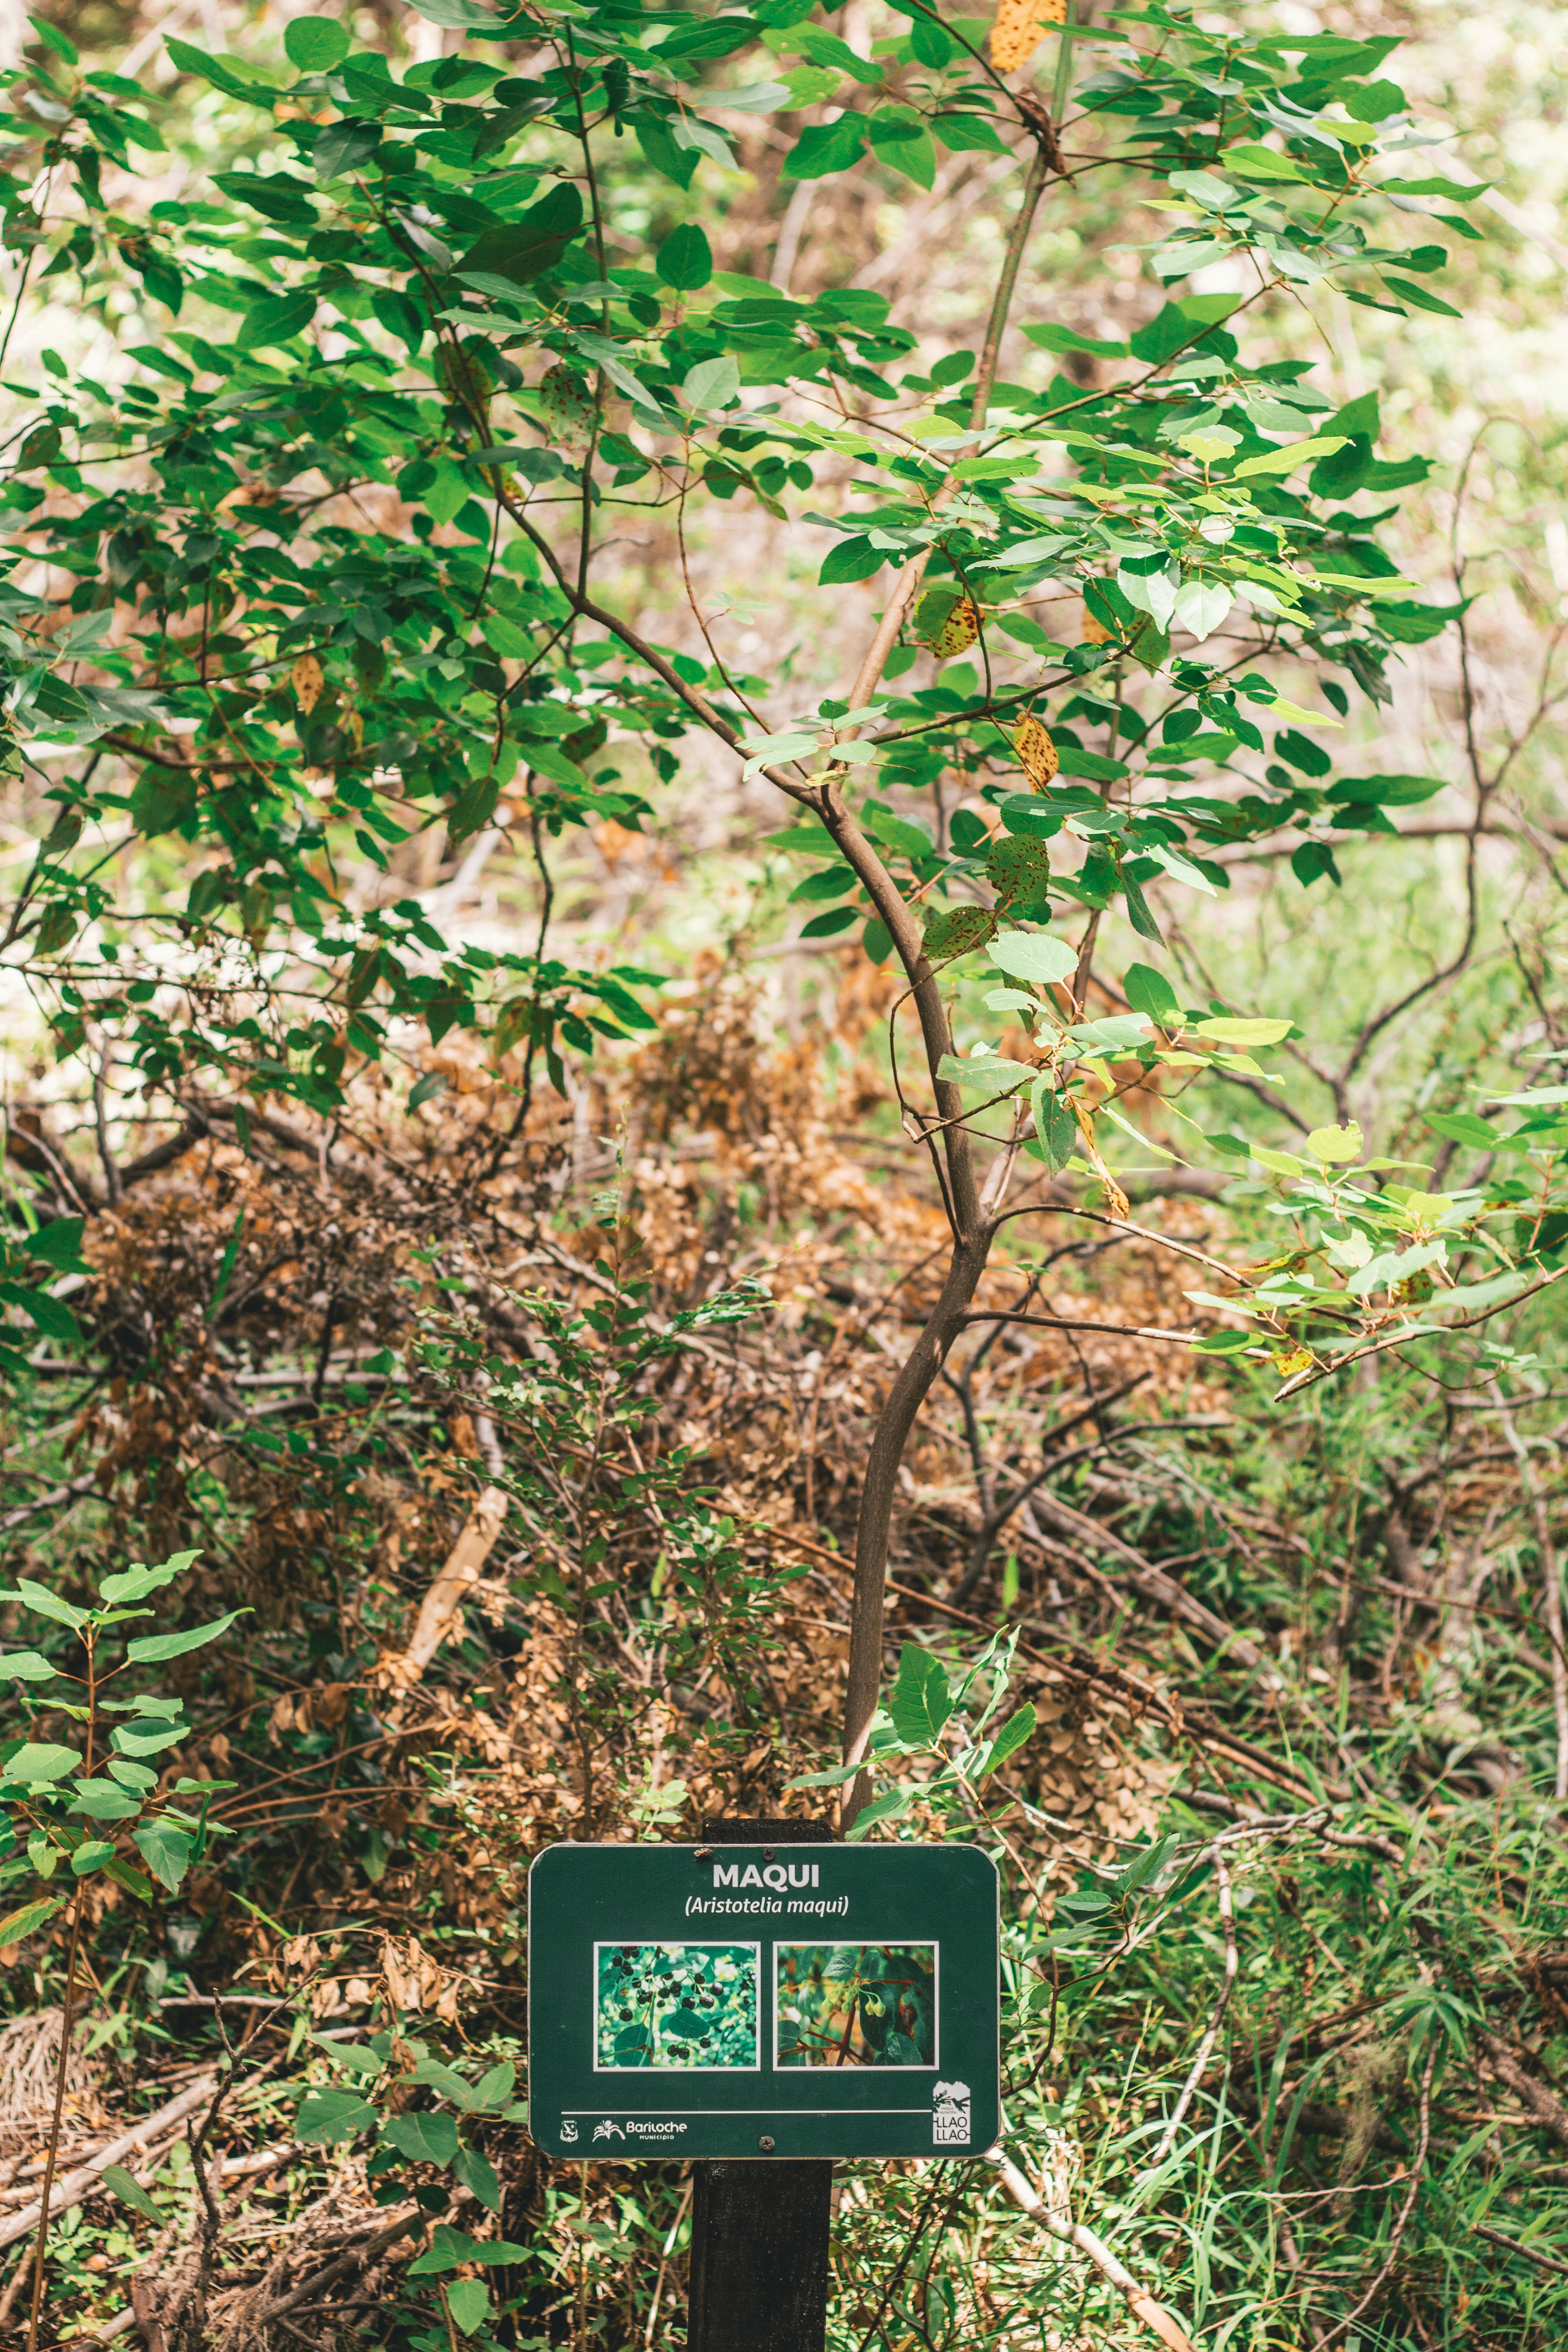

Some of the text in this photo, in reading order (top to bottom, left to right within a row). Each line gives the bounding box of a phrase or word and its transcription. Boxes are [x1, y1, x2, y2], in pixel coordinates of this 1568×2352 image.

[713, 1864, 819, 1892] MAQUI
[685, 1896, 849, 1918] (Aristotelia maqui)
[626, 2121, 687, 2132] Bariloche
[937, 2117, 967, 2128] LLAO
[937, 2129, 967, 2140] LLAO
